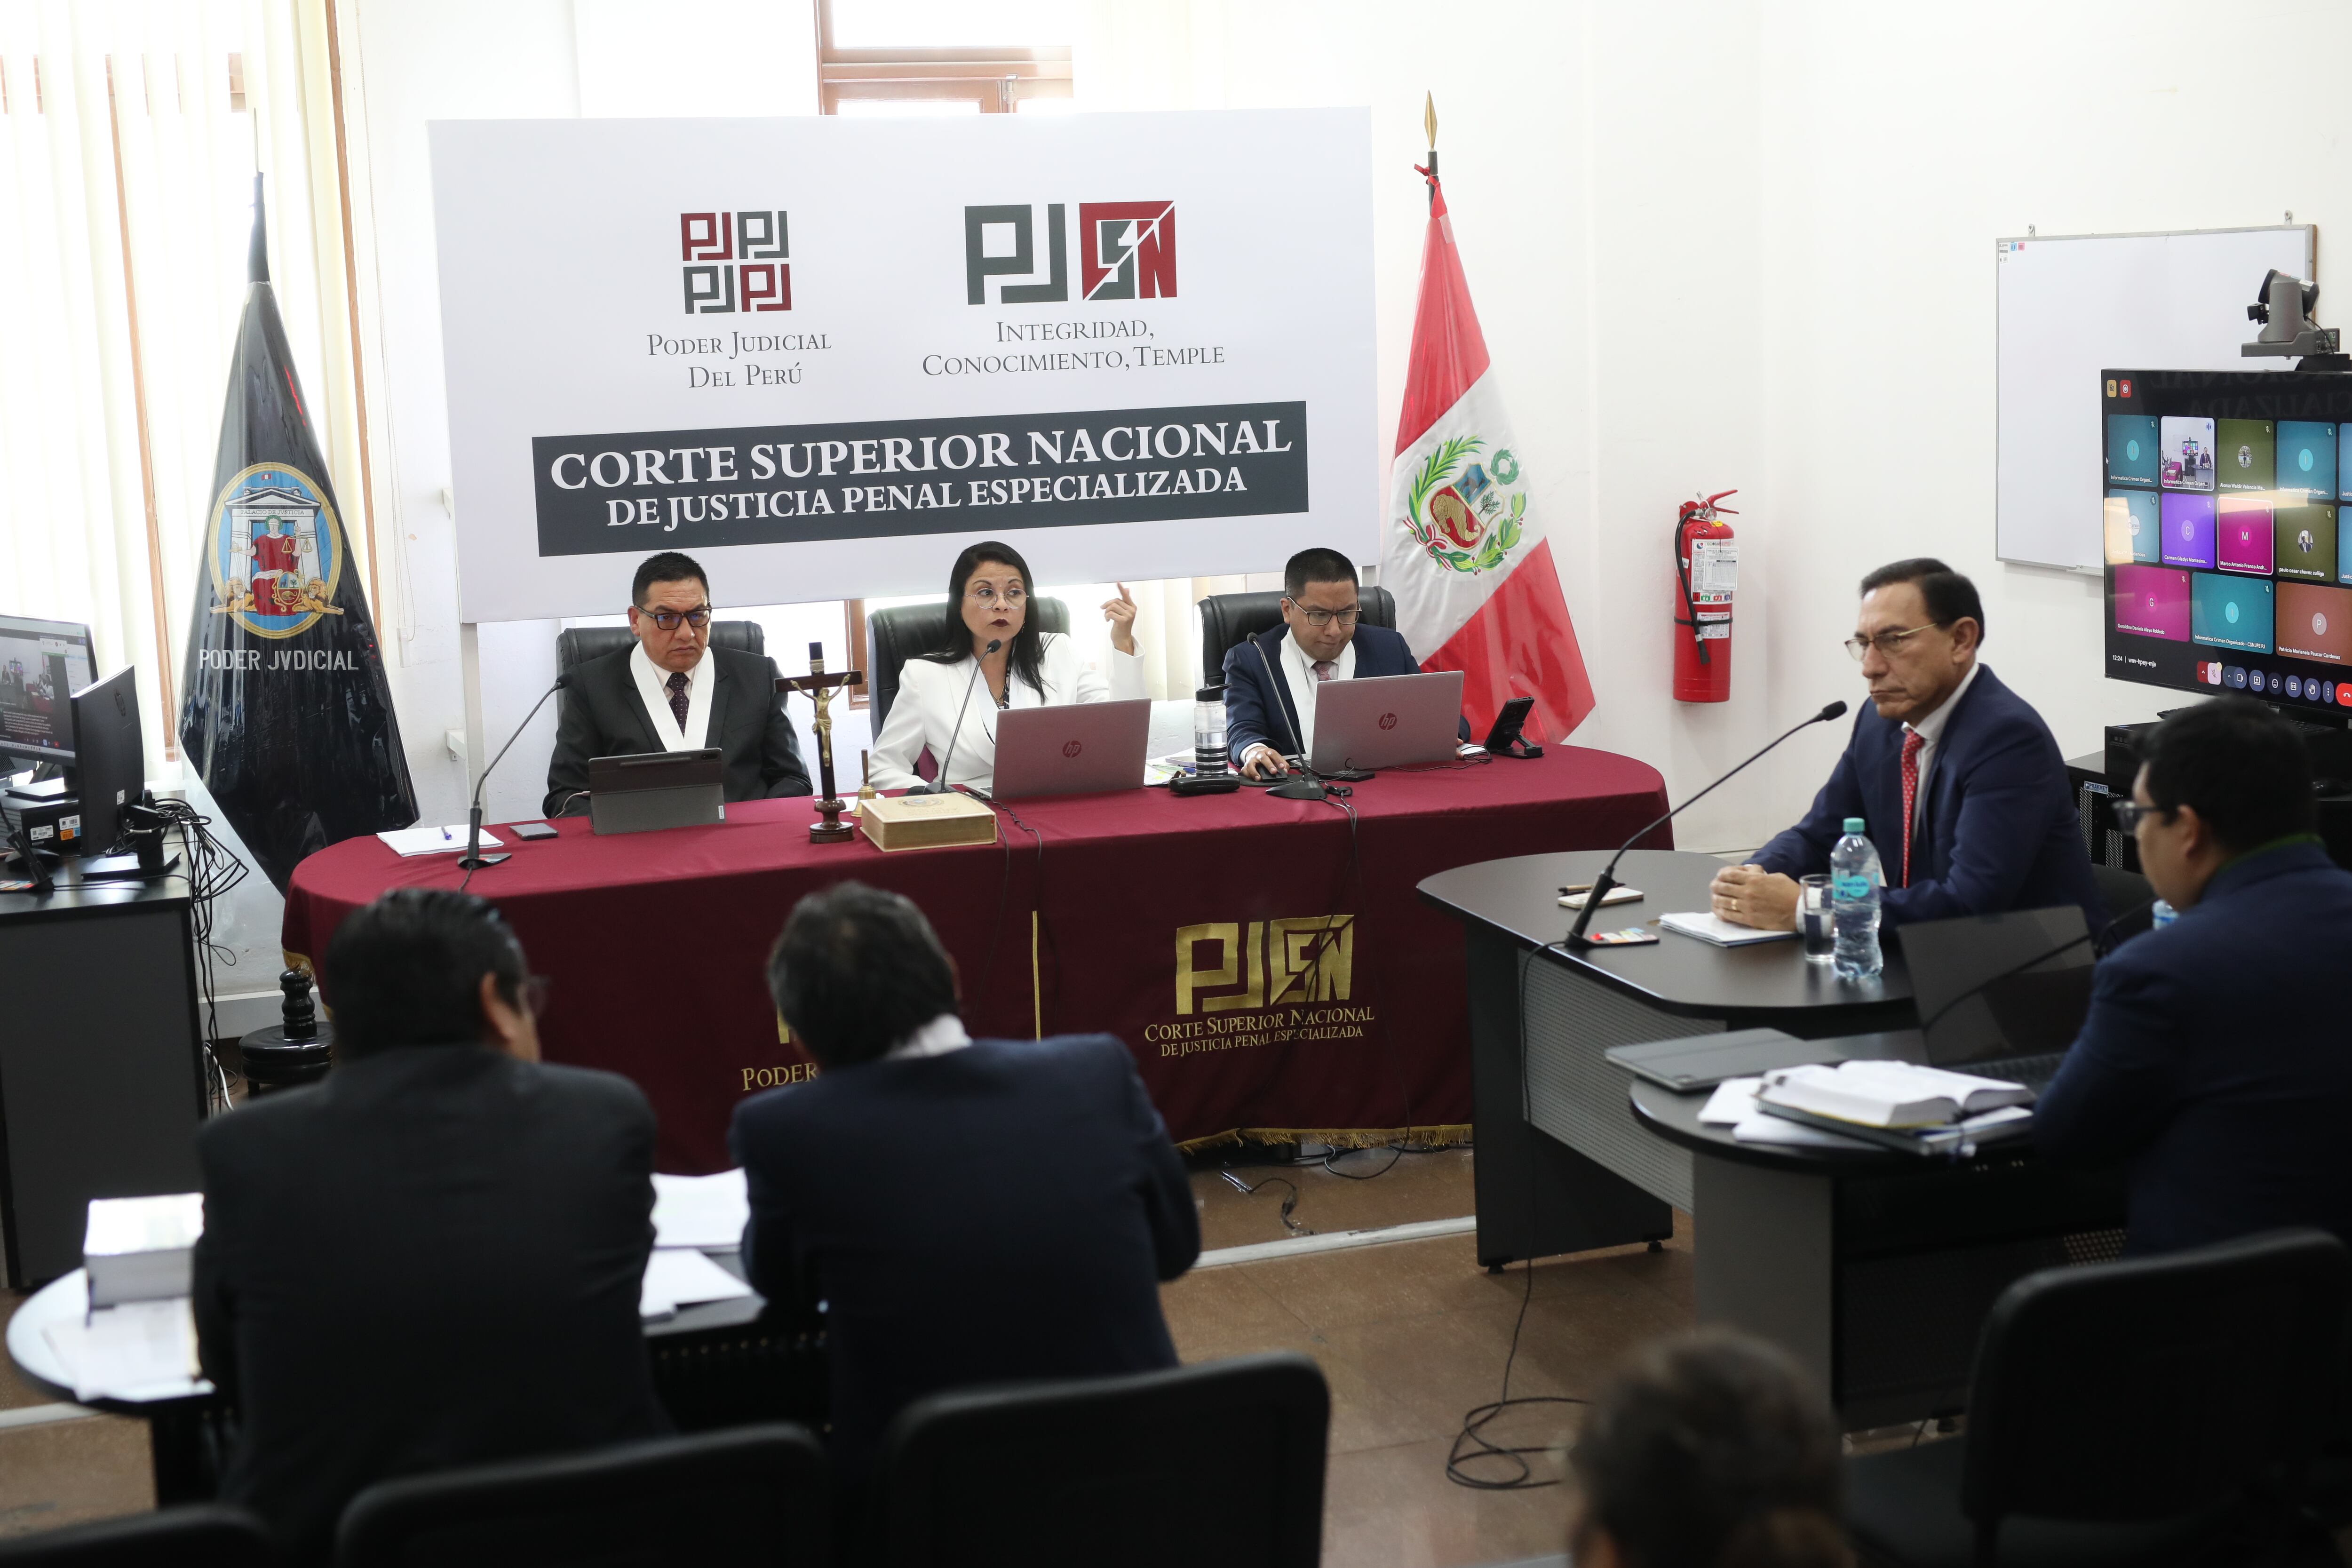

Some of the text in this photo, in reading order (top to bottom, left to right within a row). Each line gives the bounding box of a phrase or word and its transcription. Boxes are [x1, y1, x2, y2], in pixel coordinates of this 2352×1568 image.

[996, 320, 1154, 342] INTEGRIDAD,
[647, 331, 832, 359] PODER JUDICIAL
[922, 346, 1224, 376] CONOCIMIENTO, TEMPLE
[688, 361, 802, 388] DEL PERÚ
[551, 420, 1292, 490] CORTE SUPERIOR NACIONAL
[606, 466, 1248, 532] DE JUSTICIA PENAL ESPECIALIZADA
[2185, 526, 2190, 535] C
[2242, 531, 2248, 541] M
[2149, 597, 2154, 607] G
[2317, 620, 2322, 629] P
[199, 649, 359, 670] PODER JVDICIAL
[1380, 713, 1396, 730] hp
[1064, 741, 1081, 757] hp
[1145, 1007, 1375, 1041] CORTE SUPERIOR NACIONAL
[1161, 1043, 1178, 1057] DE
[1181, 1038, 1232, 1057] JUSTICIA
[1234, 1033, 1271, 1047] PENAL
[741, 1062, 818, 1091] PODER
